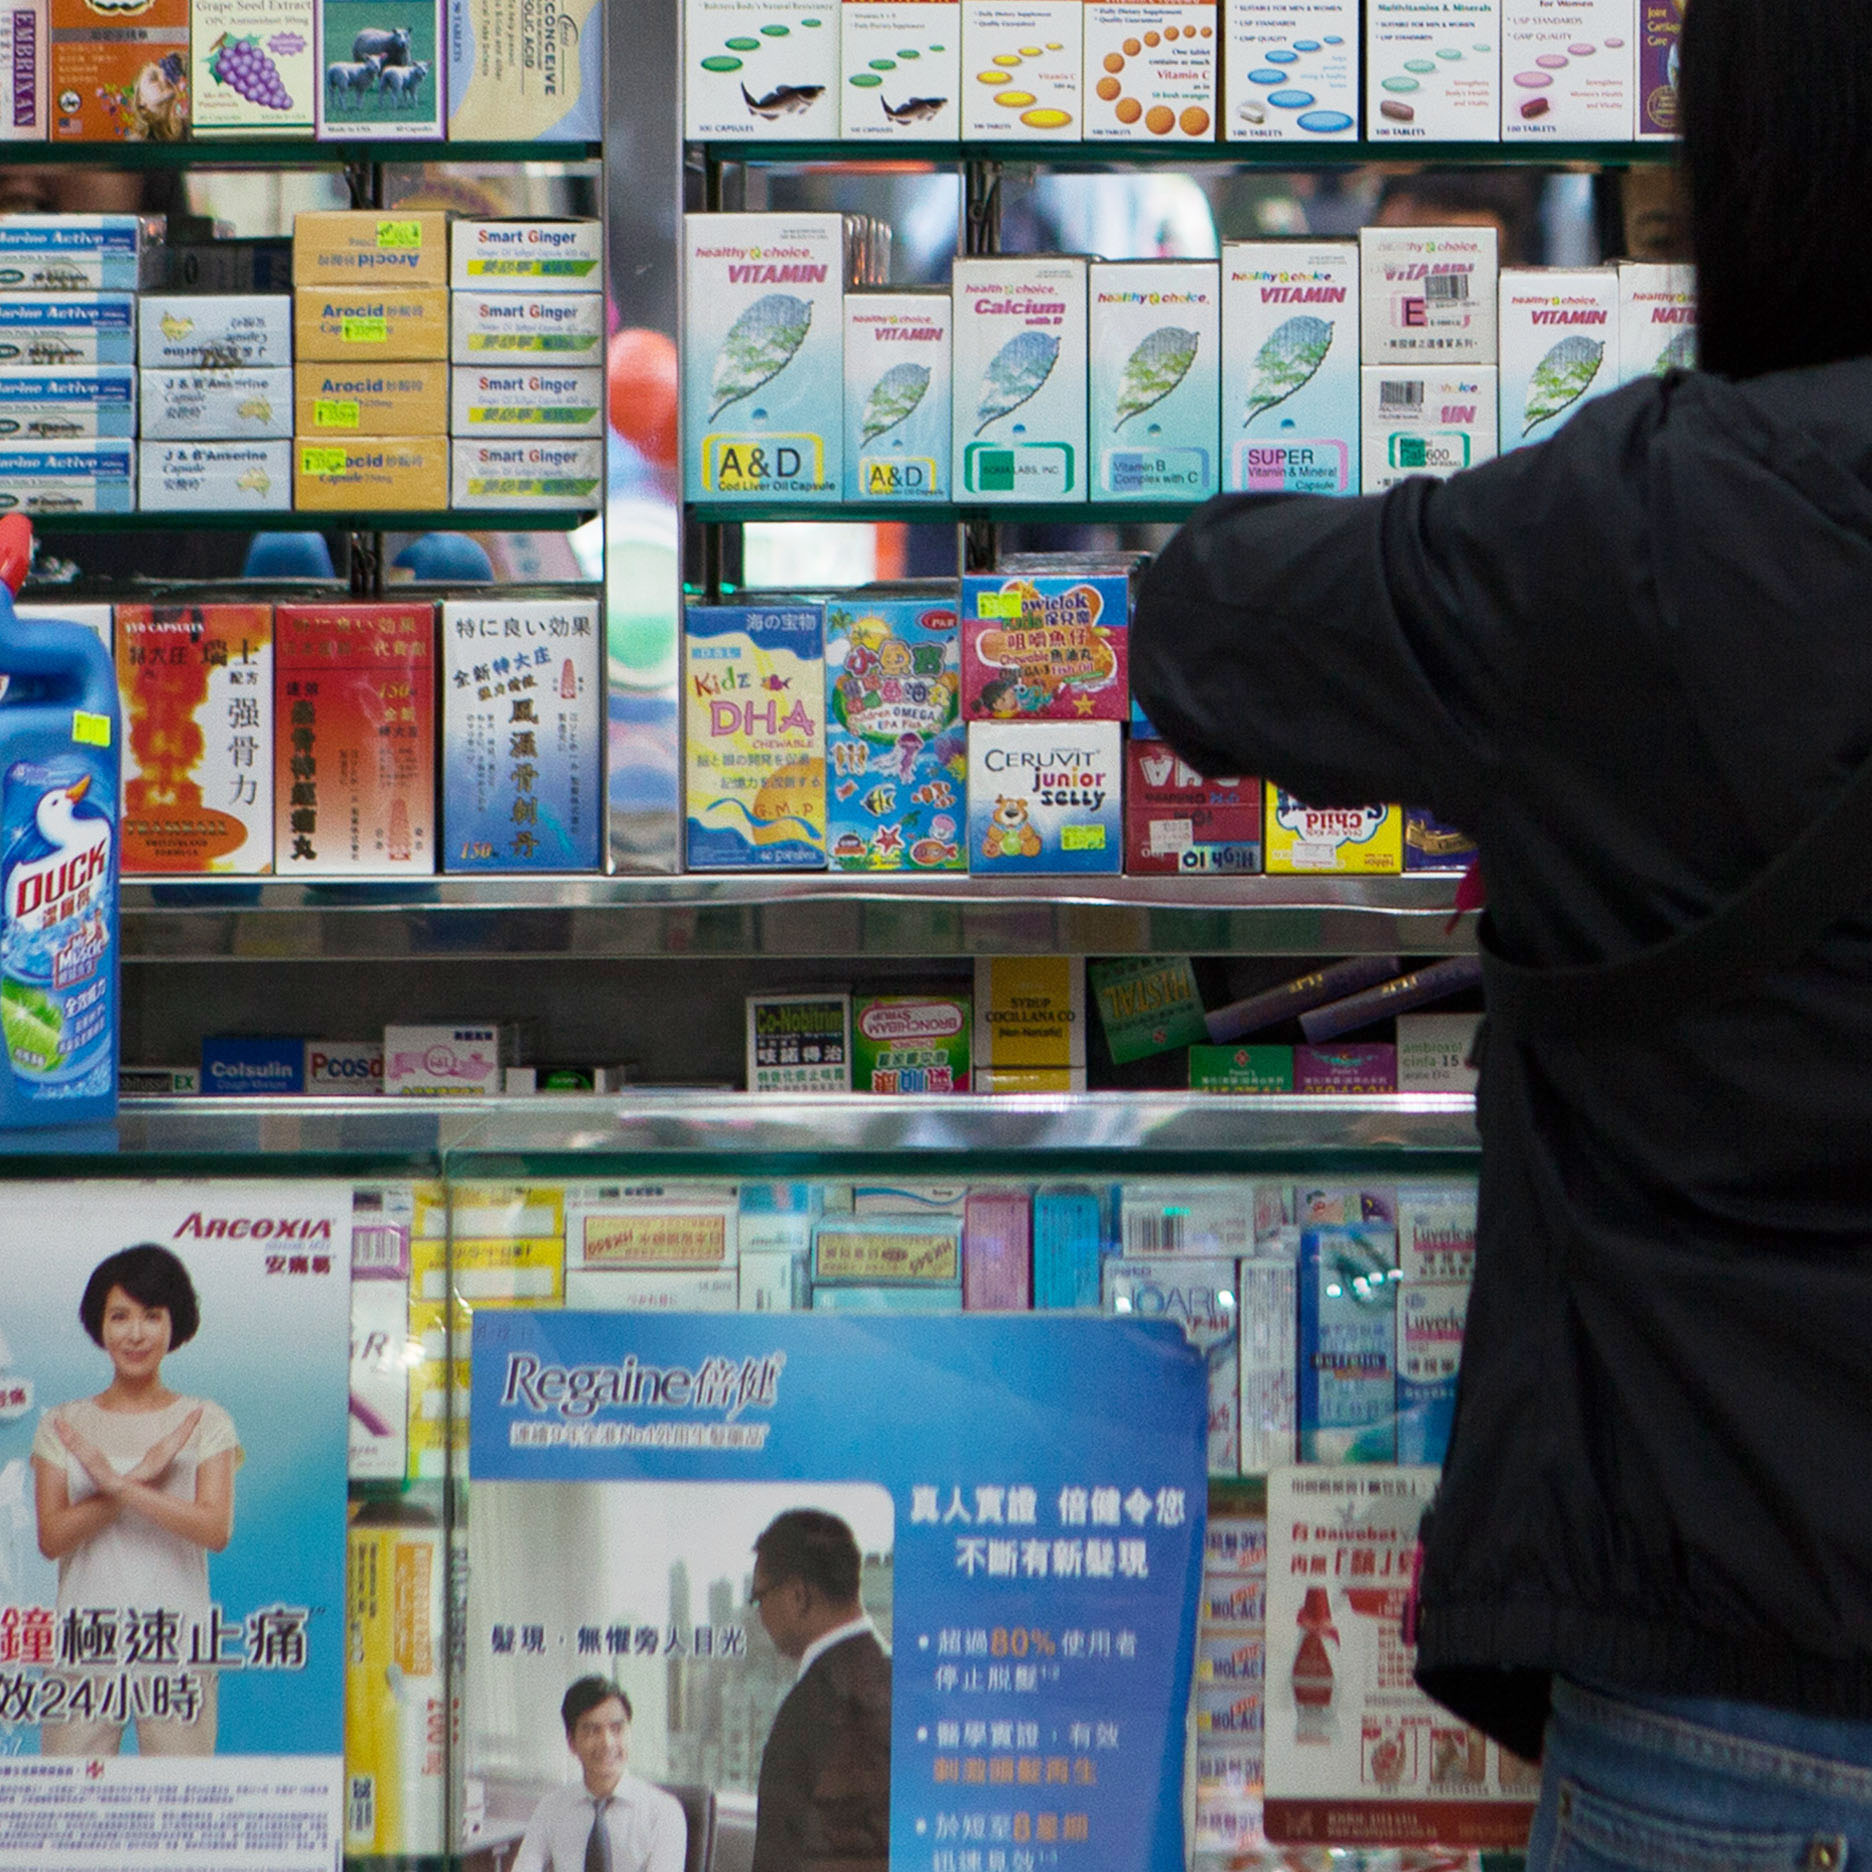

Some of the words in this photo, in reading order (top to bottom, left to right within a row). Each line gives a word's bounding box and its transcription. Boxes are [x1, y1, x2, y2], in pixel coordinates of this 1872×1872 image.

[196, 0, 228, 14] Grape
[232, 0, 260, 12] Seed
[265, 0, 312, 12] Extract
[478, 230, 523, 244] Smart
[528, 230, 577, 248] Ginger
[728, 264, 827, 284] VITAMIN
[48, 307, 98, 320] Active
[975, 300, 1066, 315] Calcium
[322, 380, 383, 393] Arocid
[1249, 449, 1314, 466] SUPER
[456, 616, 592, 639] 特に良い効果
[747, 613, 816, 630] 海の宝物
[201, 641, 260, 669] 瑞士
[694, 668, 750, 696] Kidz
[711, 702, 814, 736] DHA
[753, 740, 813, 749] CHEWABLE
[985, 749, 1097, 770] CERUVIT
[1033, 768, 1107, 793] junior
[15, 839, 108, 915] DUCK
[211, 1062, 293, 1079] Colsulin
[174, 1212, 332, 1241] ARCOXIA
[504, 1354, 690, 1416] Regaine
